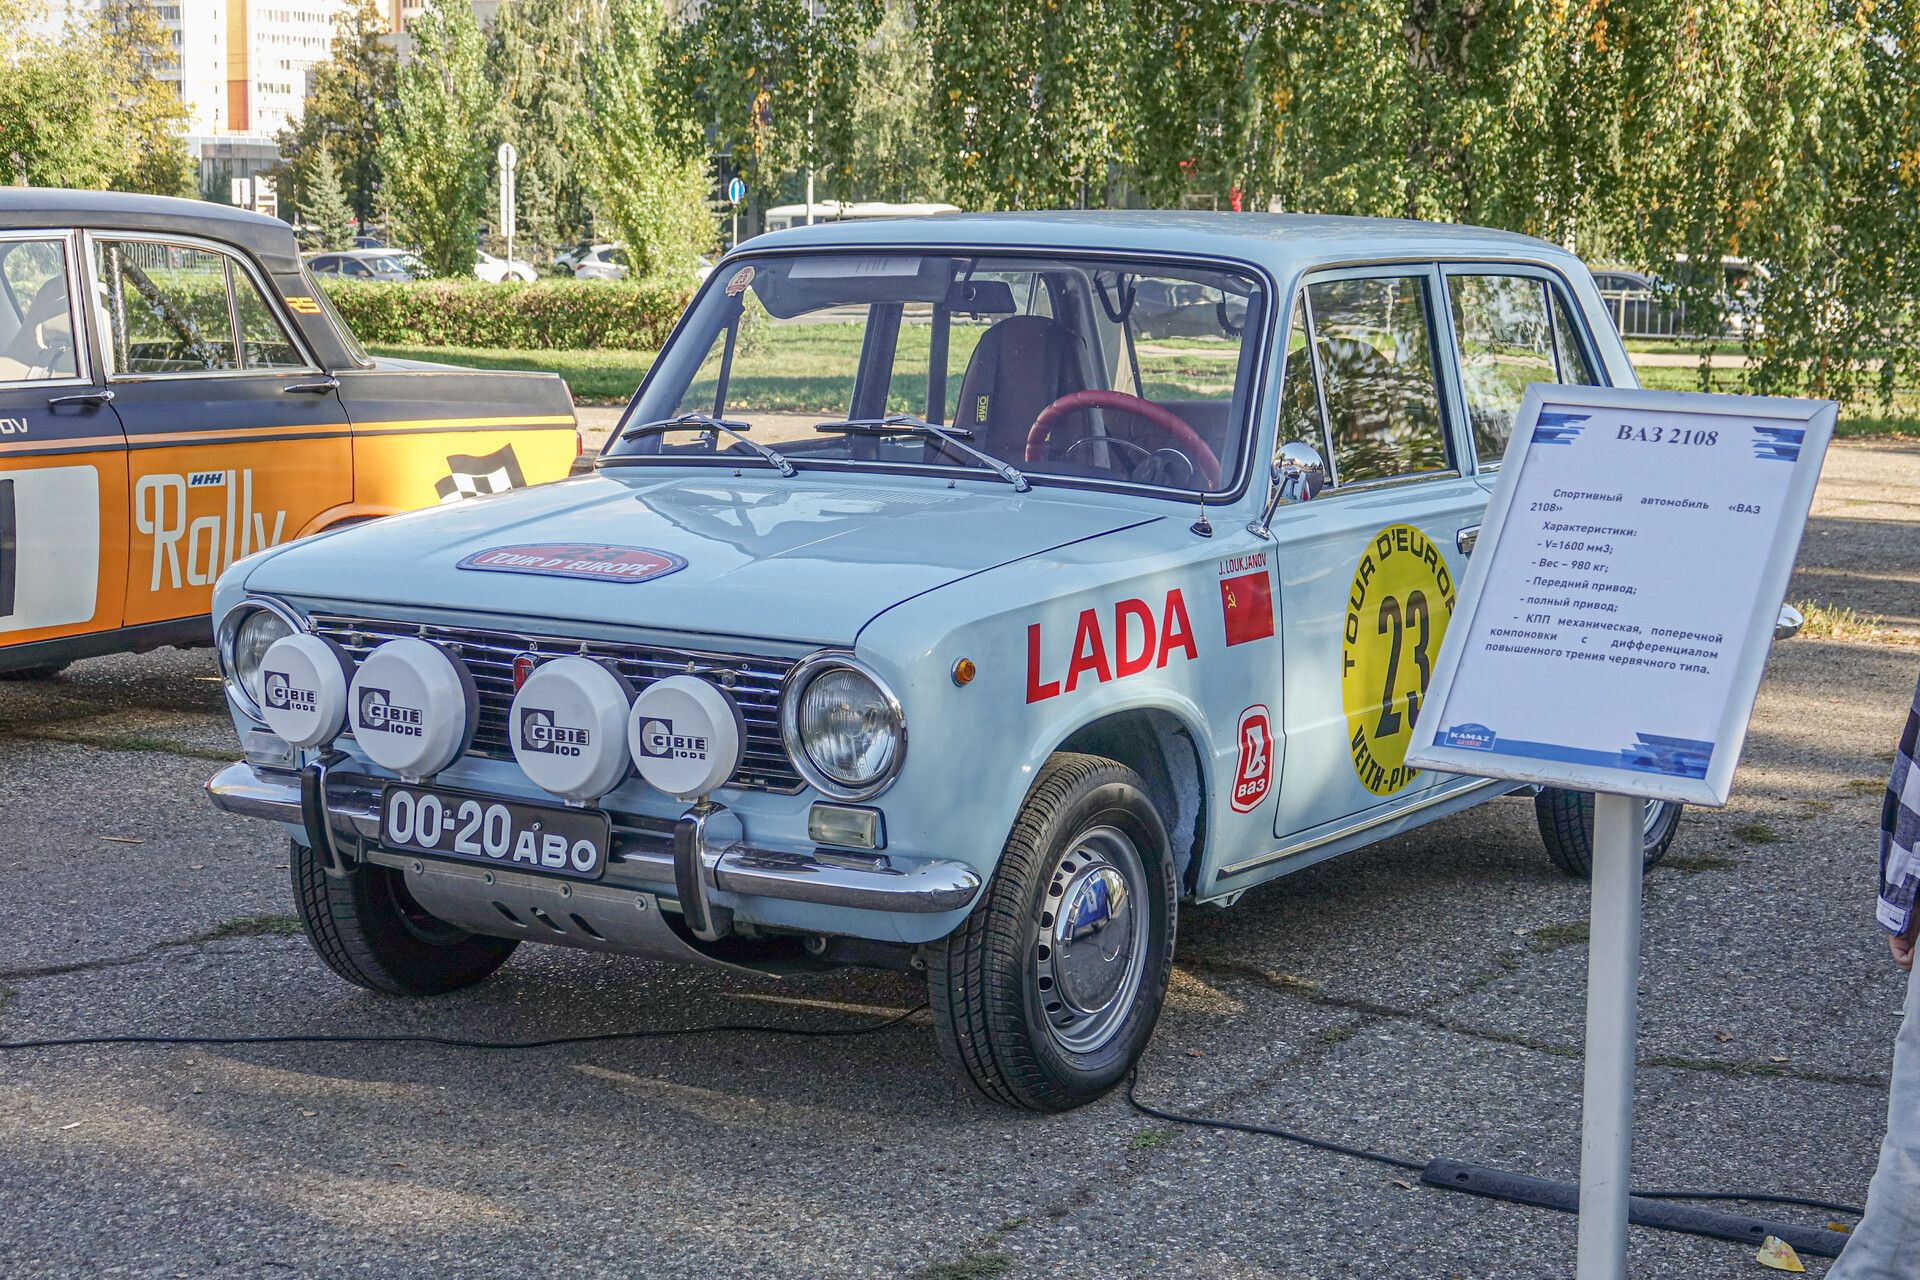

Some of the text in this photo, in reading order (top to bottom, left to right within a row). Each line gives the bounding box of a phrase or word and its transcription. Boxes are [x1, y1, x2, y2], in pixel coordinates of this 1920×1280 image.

[978, 395, 987, 421] OMP
[1616, 424, 1719, 446] ВАЗ 2108
[1530, 502, 1563, 512] 2108»
[1552, 488, 1761, 514] Спортивный автомобиль «ВАЗ
[1542, 521, 1638, 537] Характеристики:
[1545, 540, 1584, 551] V=1600
[1586, 544, 1614, 555] мм3;
[481, 552, 545, 566] TOUR
[1539, 558, 1559, 568] Вес
[1570, 560, 1591, 571] 980
[1593, 563, 1609, 574] кг;
[1532, 576, 1589, 591] Передний
[1591, 582, 1638, 596] привод;
[1526, 595, 1570, 607] полный
[1572, 600, 1619, 613] привод;
[1344, 554, 1376, 678] TOUR
[1526, 613, 1551, 625] КПП
[1557, 617, 1643, 635] механическая,
[1650, 626, 1724, 644] поперечной
[1026, 588, 1198, 704] LADA
[1489, 626, 1718, 659] компоновки с дифференциалом
[1374, 589, 1430, 738] 23
[1485, 642, 1710, 675] повышенного трения червячного типа.
[291, 702, 316, 712] IODE
[390, 724, 422, 737] IODE
[1450, 732, 1490, 742] KAMAZ
[555, 745, 581, 757] IOD
[675, 751, 706, 760] IODE
[388, 790, 512, 859] 00-20
